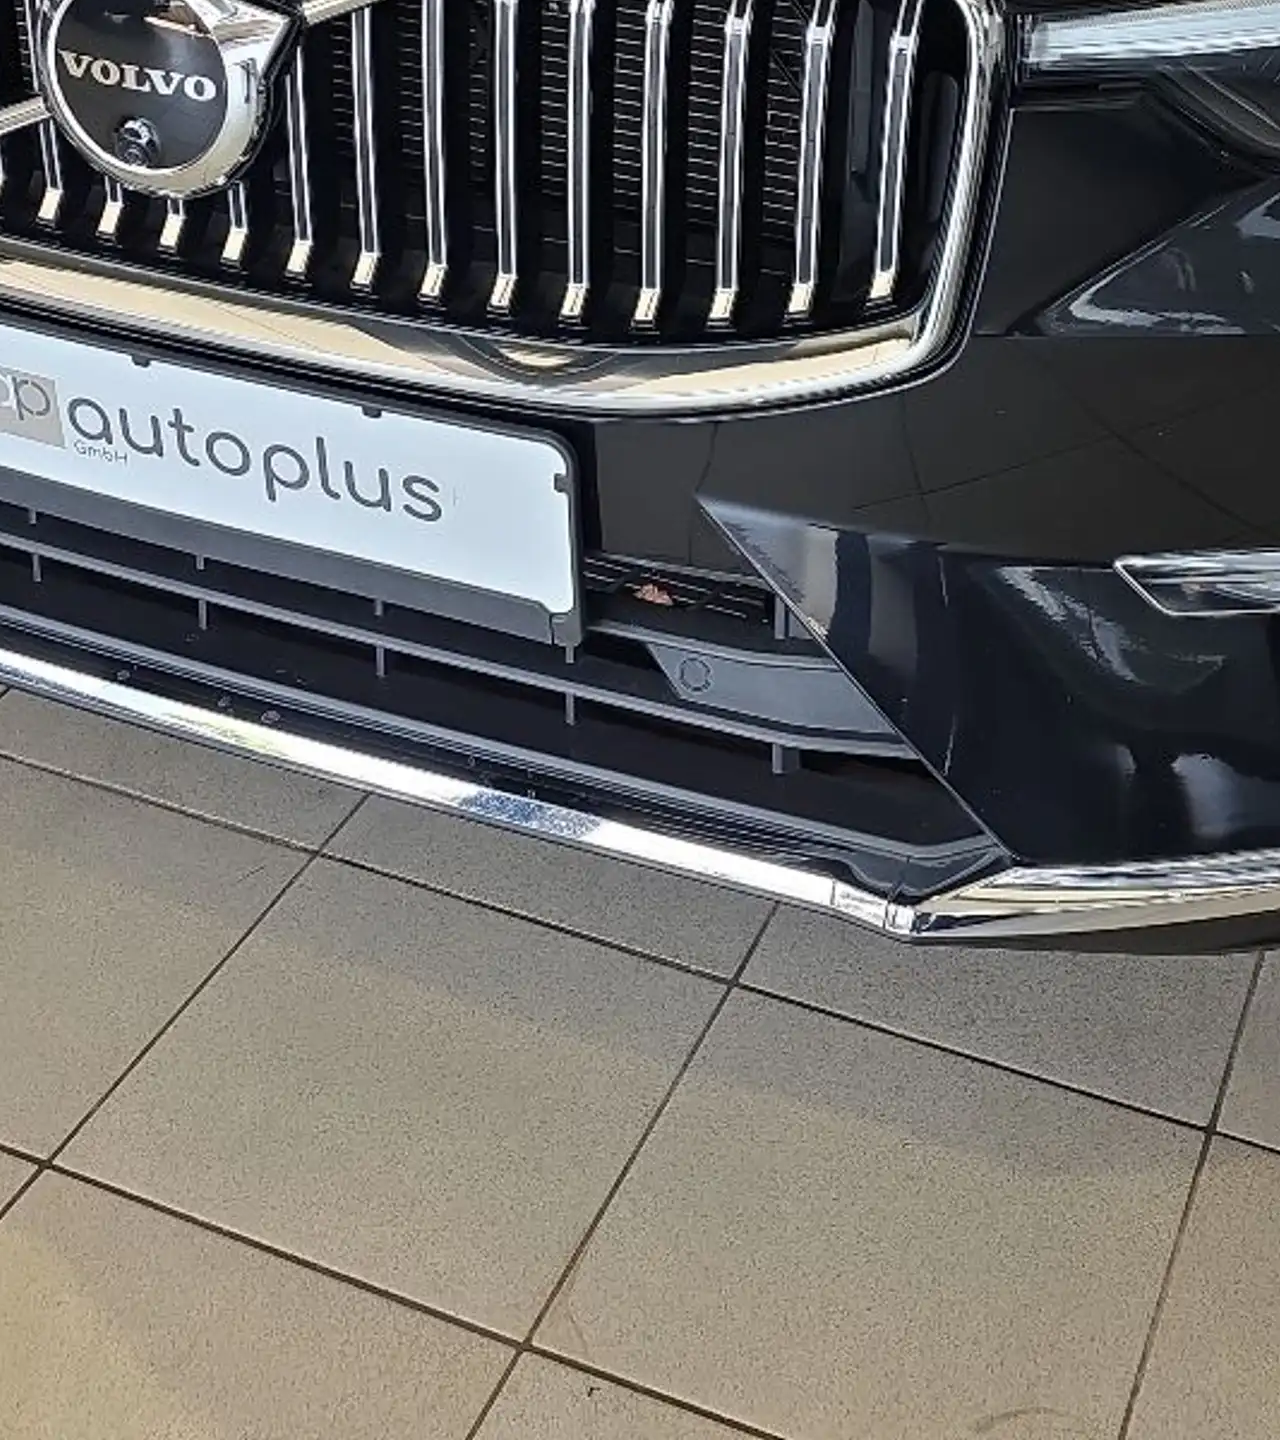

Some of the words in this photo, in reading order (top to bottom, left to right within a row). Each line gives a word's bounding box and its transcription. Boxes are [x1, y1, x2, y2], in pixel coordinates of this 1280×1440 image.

[58, 49, 218, 103] VOLVO
[66, 396, 444, 524] autoplus
[73, 438, 129, 467] GmbH
